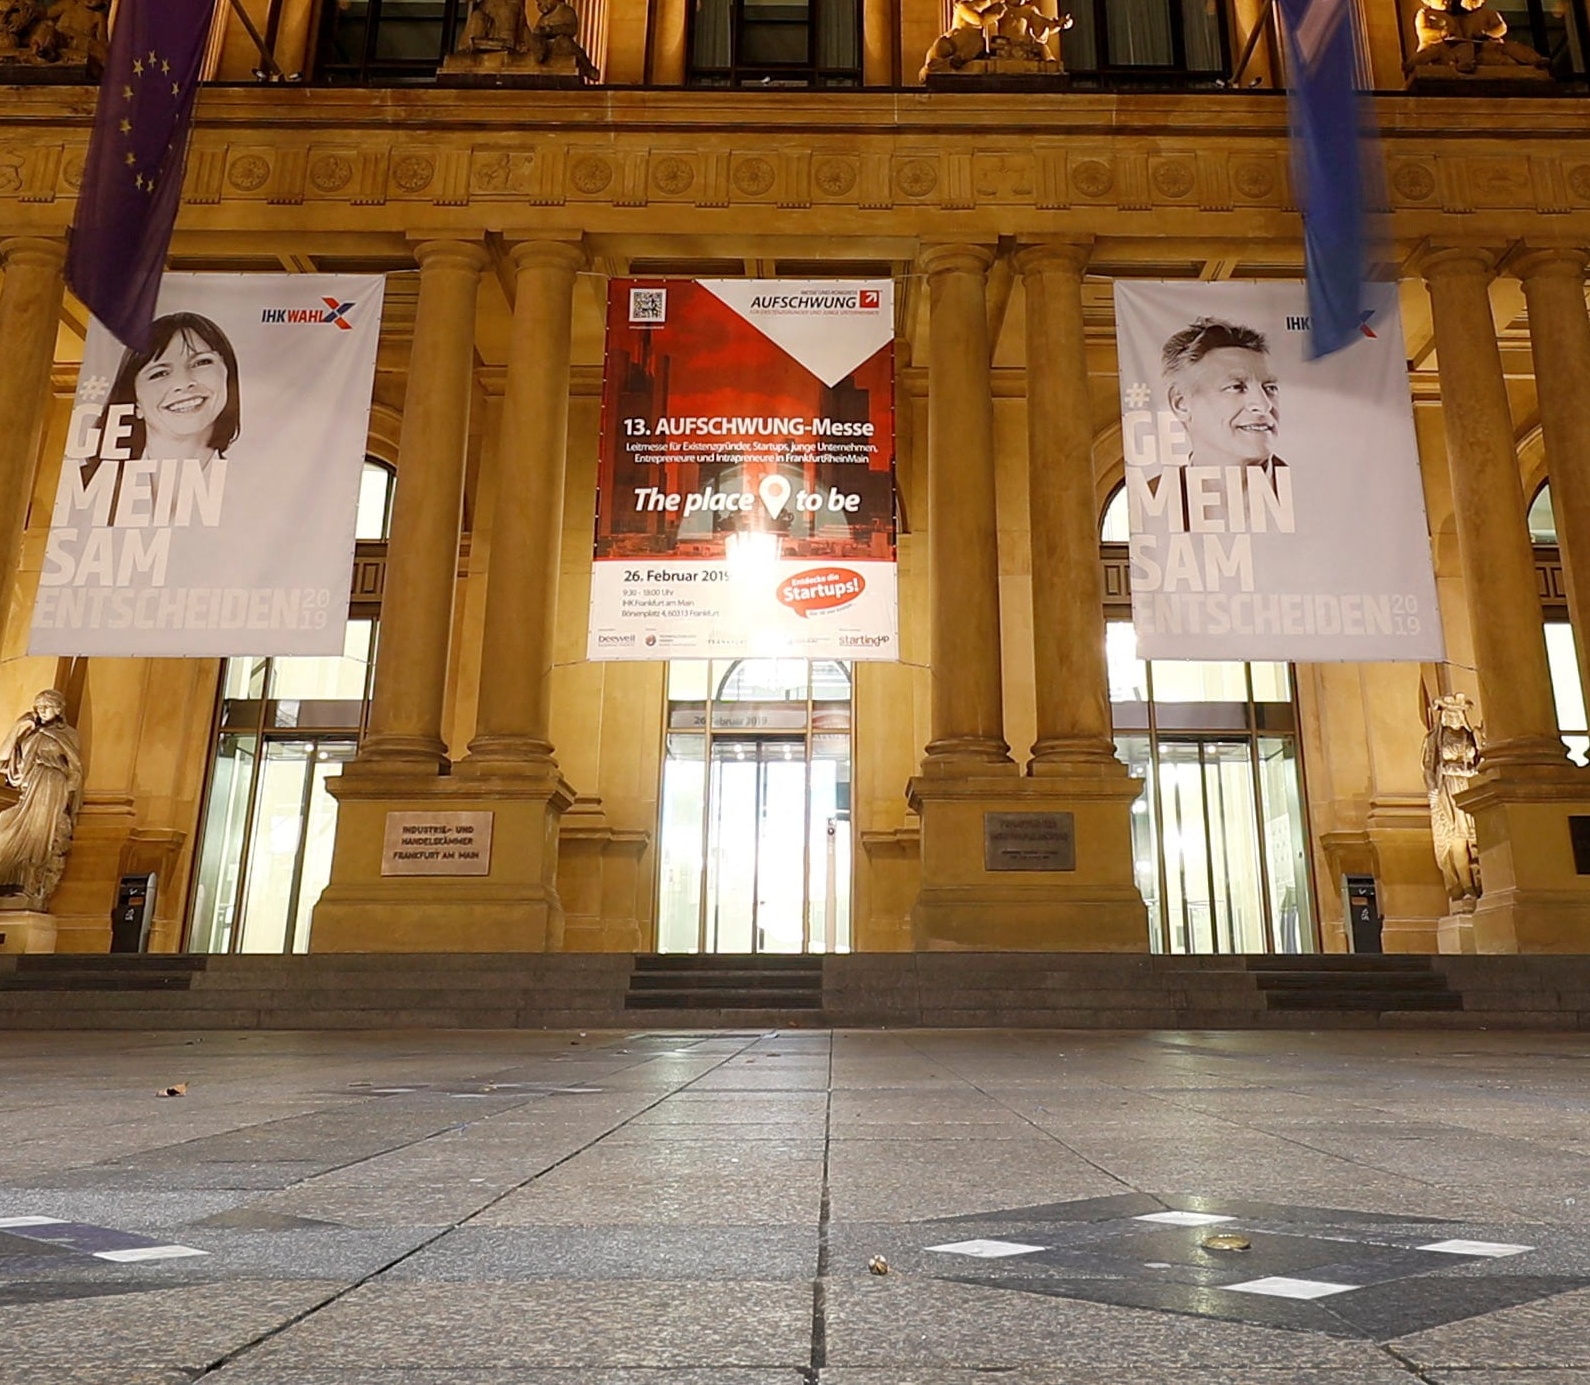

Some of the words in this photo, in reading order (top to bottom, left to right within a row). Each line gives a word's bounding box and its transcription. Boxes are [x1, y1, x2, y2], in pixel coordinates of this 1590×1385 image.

[750, 296, 857, 309] AUFSCHWUNG
[65, 403, 135, 460] GE
[623, 418, 651, 435] 13.
[655, 417, 875, 436] AUFSCHWUNG-Messe
[1124, 411, 1192, 466] GE
[626, 442, 668, 451] Leitmesse
[669, 442, 681, 451] für
[790, 442, 816, 453] junge
[817, 442, 878, 453] Unternehmen,
[634, 454, 695, 464] Entrepreneure
[697, 454, 714, 463] und
[716, 454, 774, 464] Intrapreneure
[775, 454, 784, 463] in
[52, 459, 229, 528] MEIN
[634, 486, 681, 511] The
[683, 486, 755, 517] place
[796, 489, 822, 512] to
[827, 486, 861, 512] be
[1126, 465, 1296, 533] MEIN
[40, 527, 172, 587] SAM
[1130, 533, 1255, 593] SAM
[624, 570, 644, 582] 26.
[647, 569, 698, 582] Februar
[783, 577, 859, 602] Startups!
[34, 587, 303, 630] ENTSCHEIDEN
[1134, 594, 1394, 636] ENTSCHEIDEN
[456, 826, 474, 834] UND
[393, 851, 439, 860] FRANKFURT
[441, 851, 455, 859] AM
[458, 851, 479, 859] MAIN
